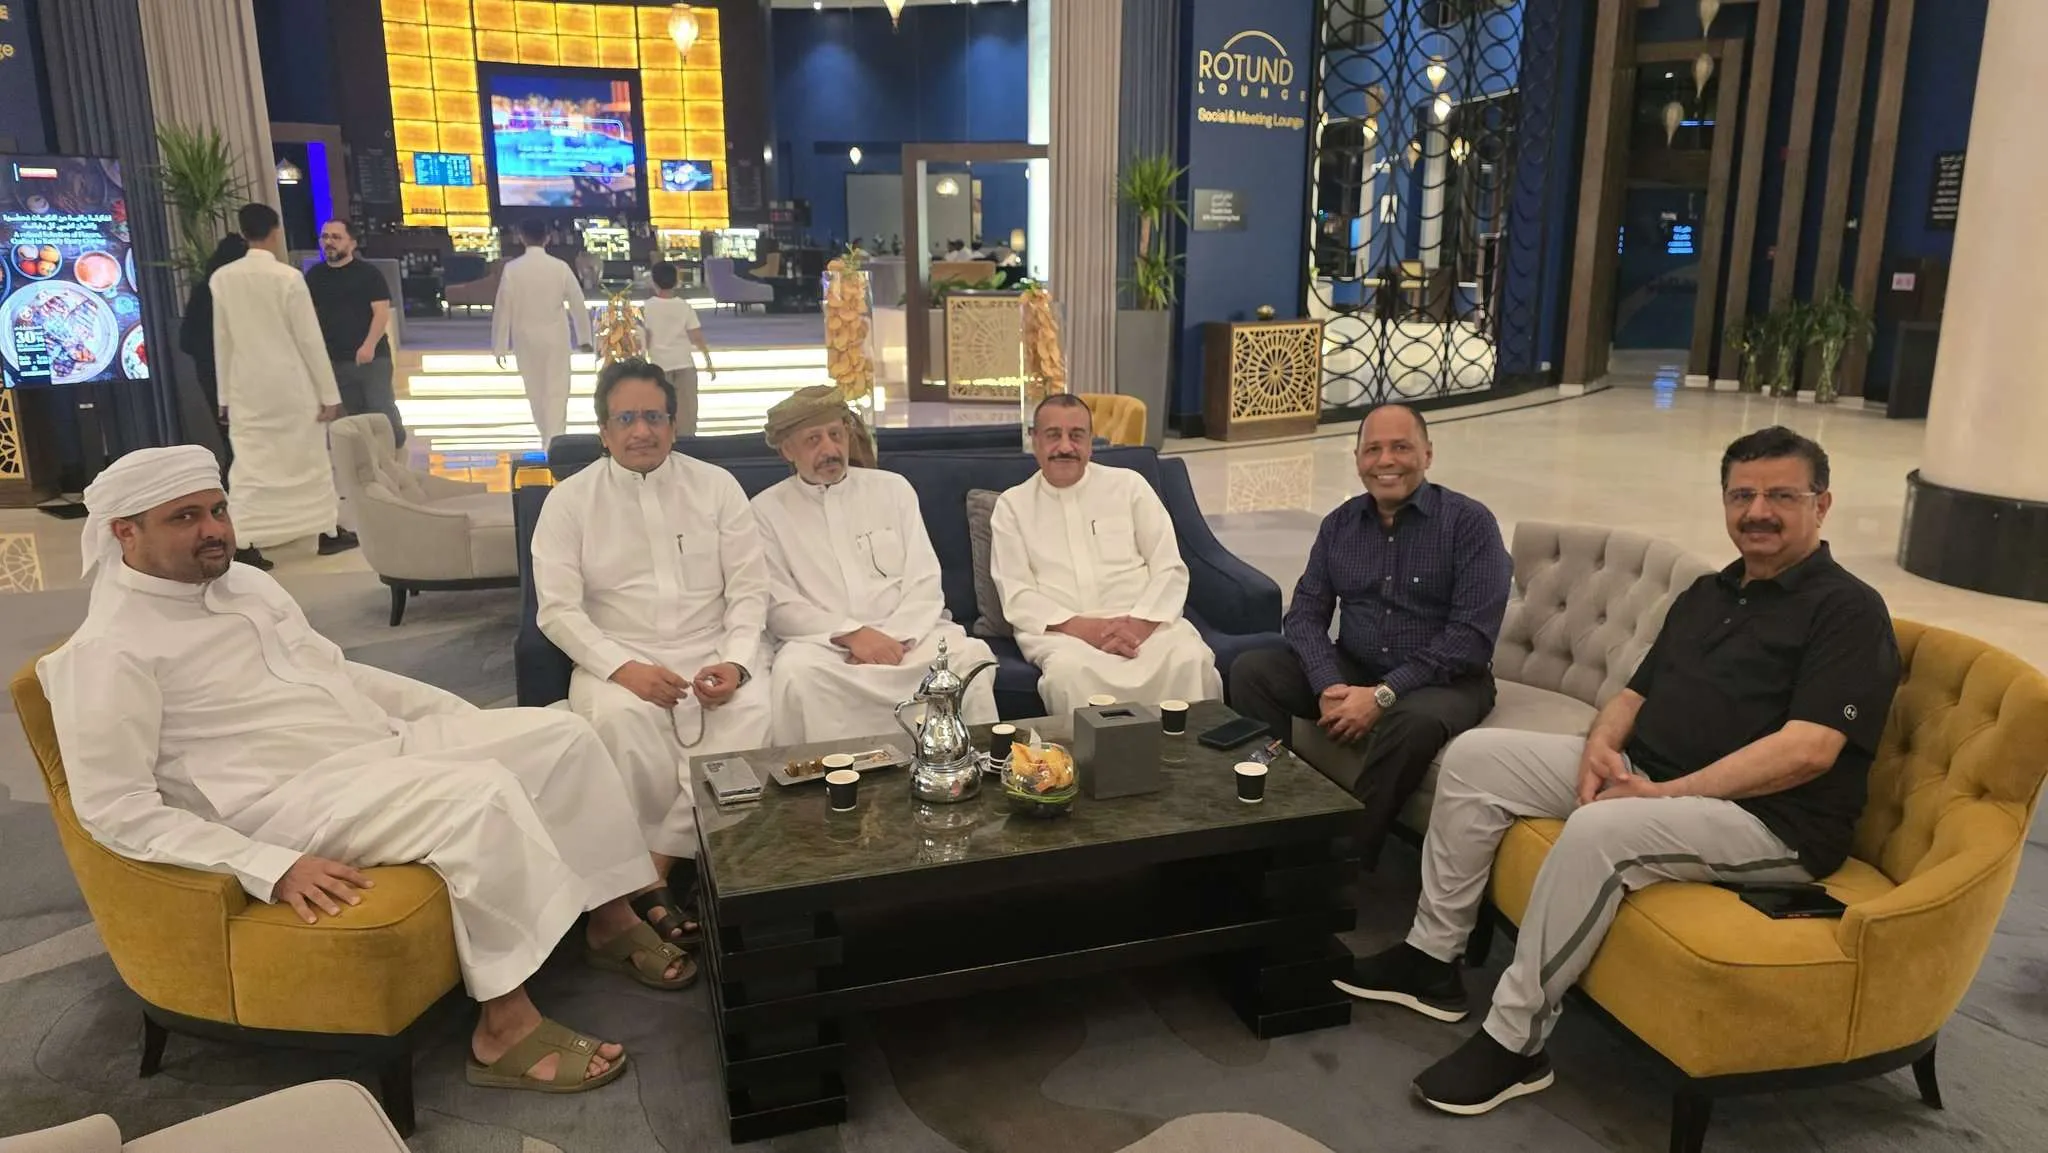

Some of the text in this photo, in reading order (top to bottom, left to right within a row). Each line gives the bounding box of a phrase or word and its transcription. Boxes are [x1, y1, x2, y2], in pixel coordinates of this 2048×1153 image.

[1199, 50, 1294, 86] ROTUND
[1198, 80, 1306, 102] LOUNGE
[1198, 107, 1305, 130] Social & Meeting Lounge
[16, 331, 36, 344] 30
